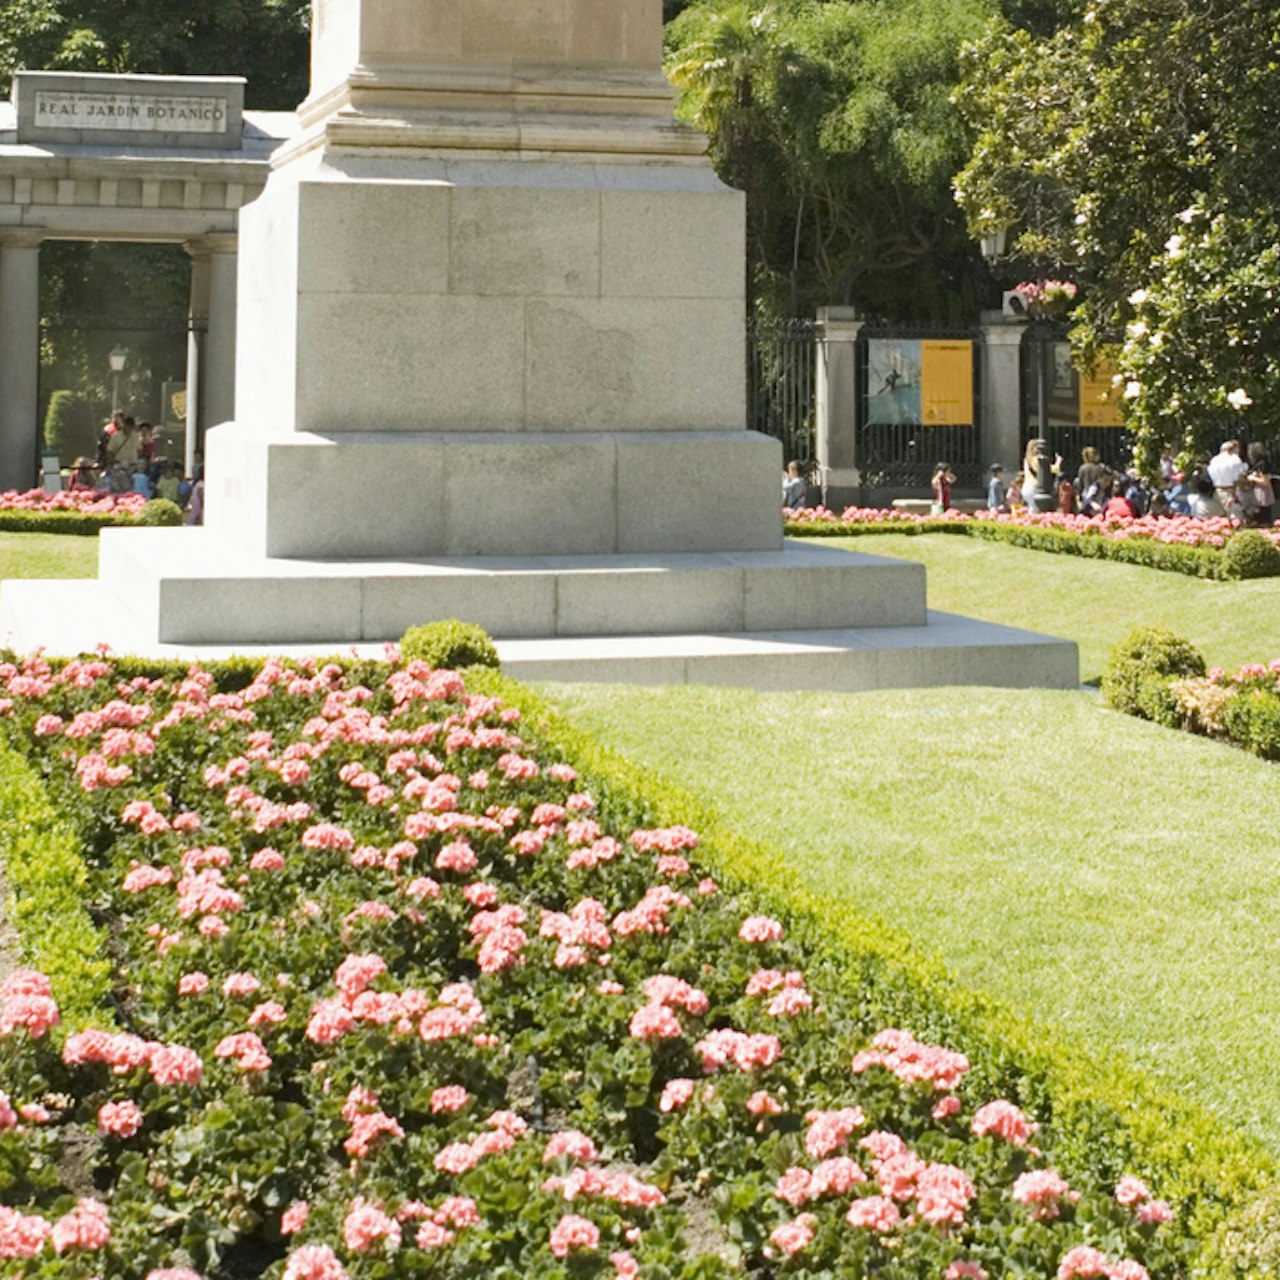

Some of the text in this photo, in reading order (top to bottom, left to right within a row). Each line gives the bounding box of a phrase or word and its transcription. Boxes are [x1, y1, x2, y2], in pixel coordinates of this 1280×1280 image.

[39, 102, 224, 120] REAL JARDIN BOTANICO
